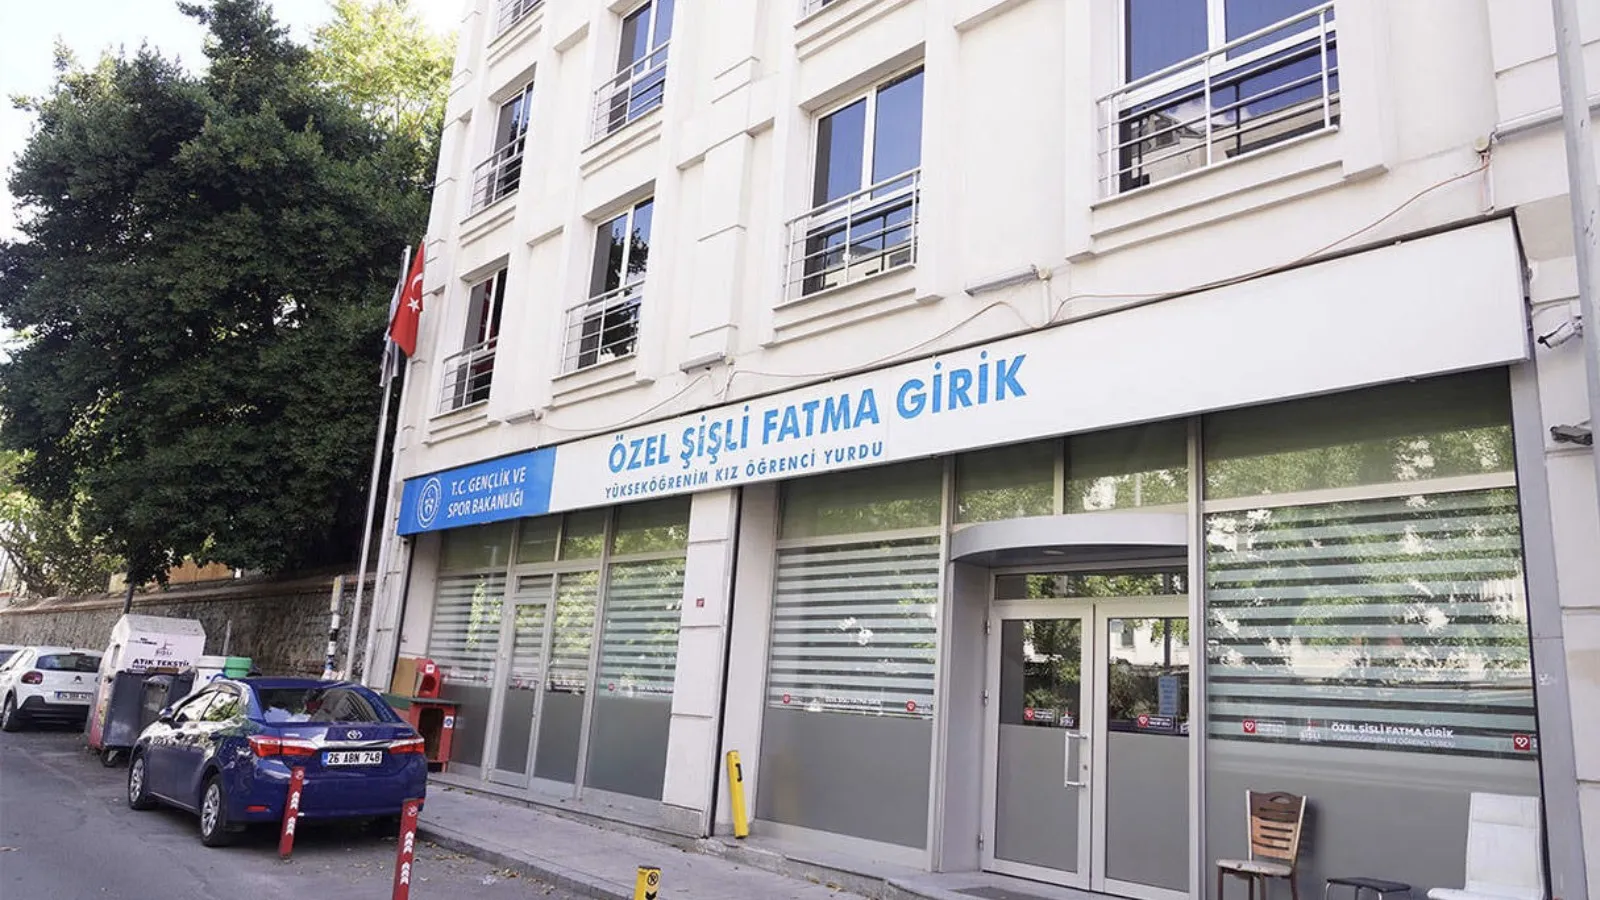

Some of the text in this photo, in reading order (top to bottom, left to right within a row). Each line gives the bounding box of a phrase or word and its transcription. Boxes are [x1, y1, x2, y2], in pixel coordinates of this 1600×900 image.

[609, 350, 1027, 474] ÖZEL ŞİŞLİ FATMA GİRİK
[451, 466, 527, 496] T.C. GENÇLİK VE
[605, 441, 883, 499] YÜKSEKÖĞRENİM KIZ ÖĞRENCİ YURDU
[447, 488, 524, 519] SPOR BAKANLIĞI
[1331, 721, 1358, 733] ÖZEL
[1386, 726, 1423, 737] FATMA
[1424, 726, 1455, 739] GİRİK
[328, 752, 381, 764] 26 ABN 748
